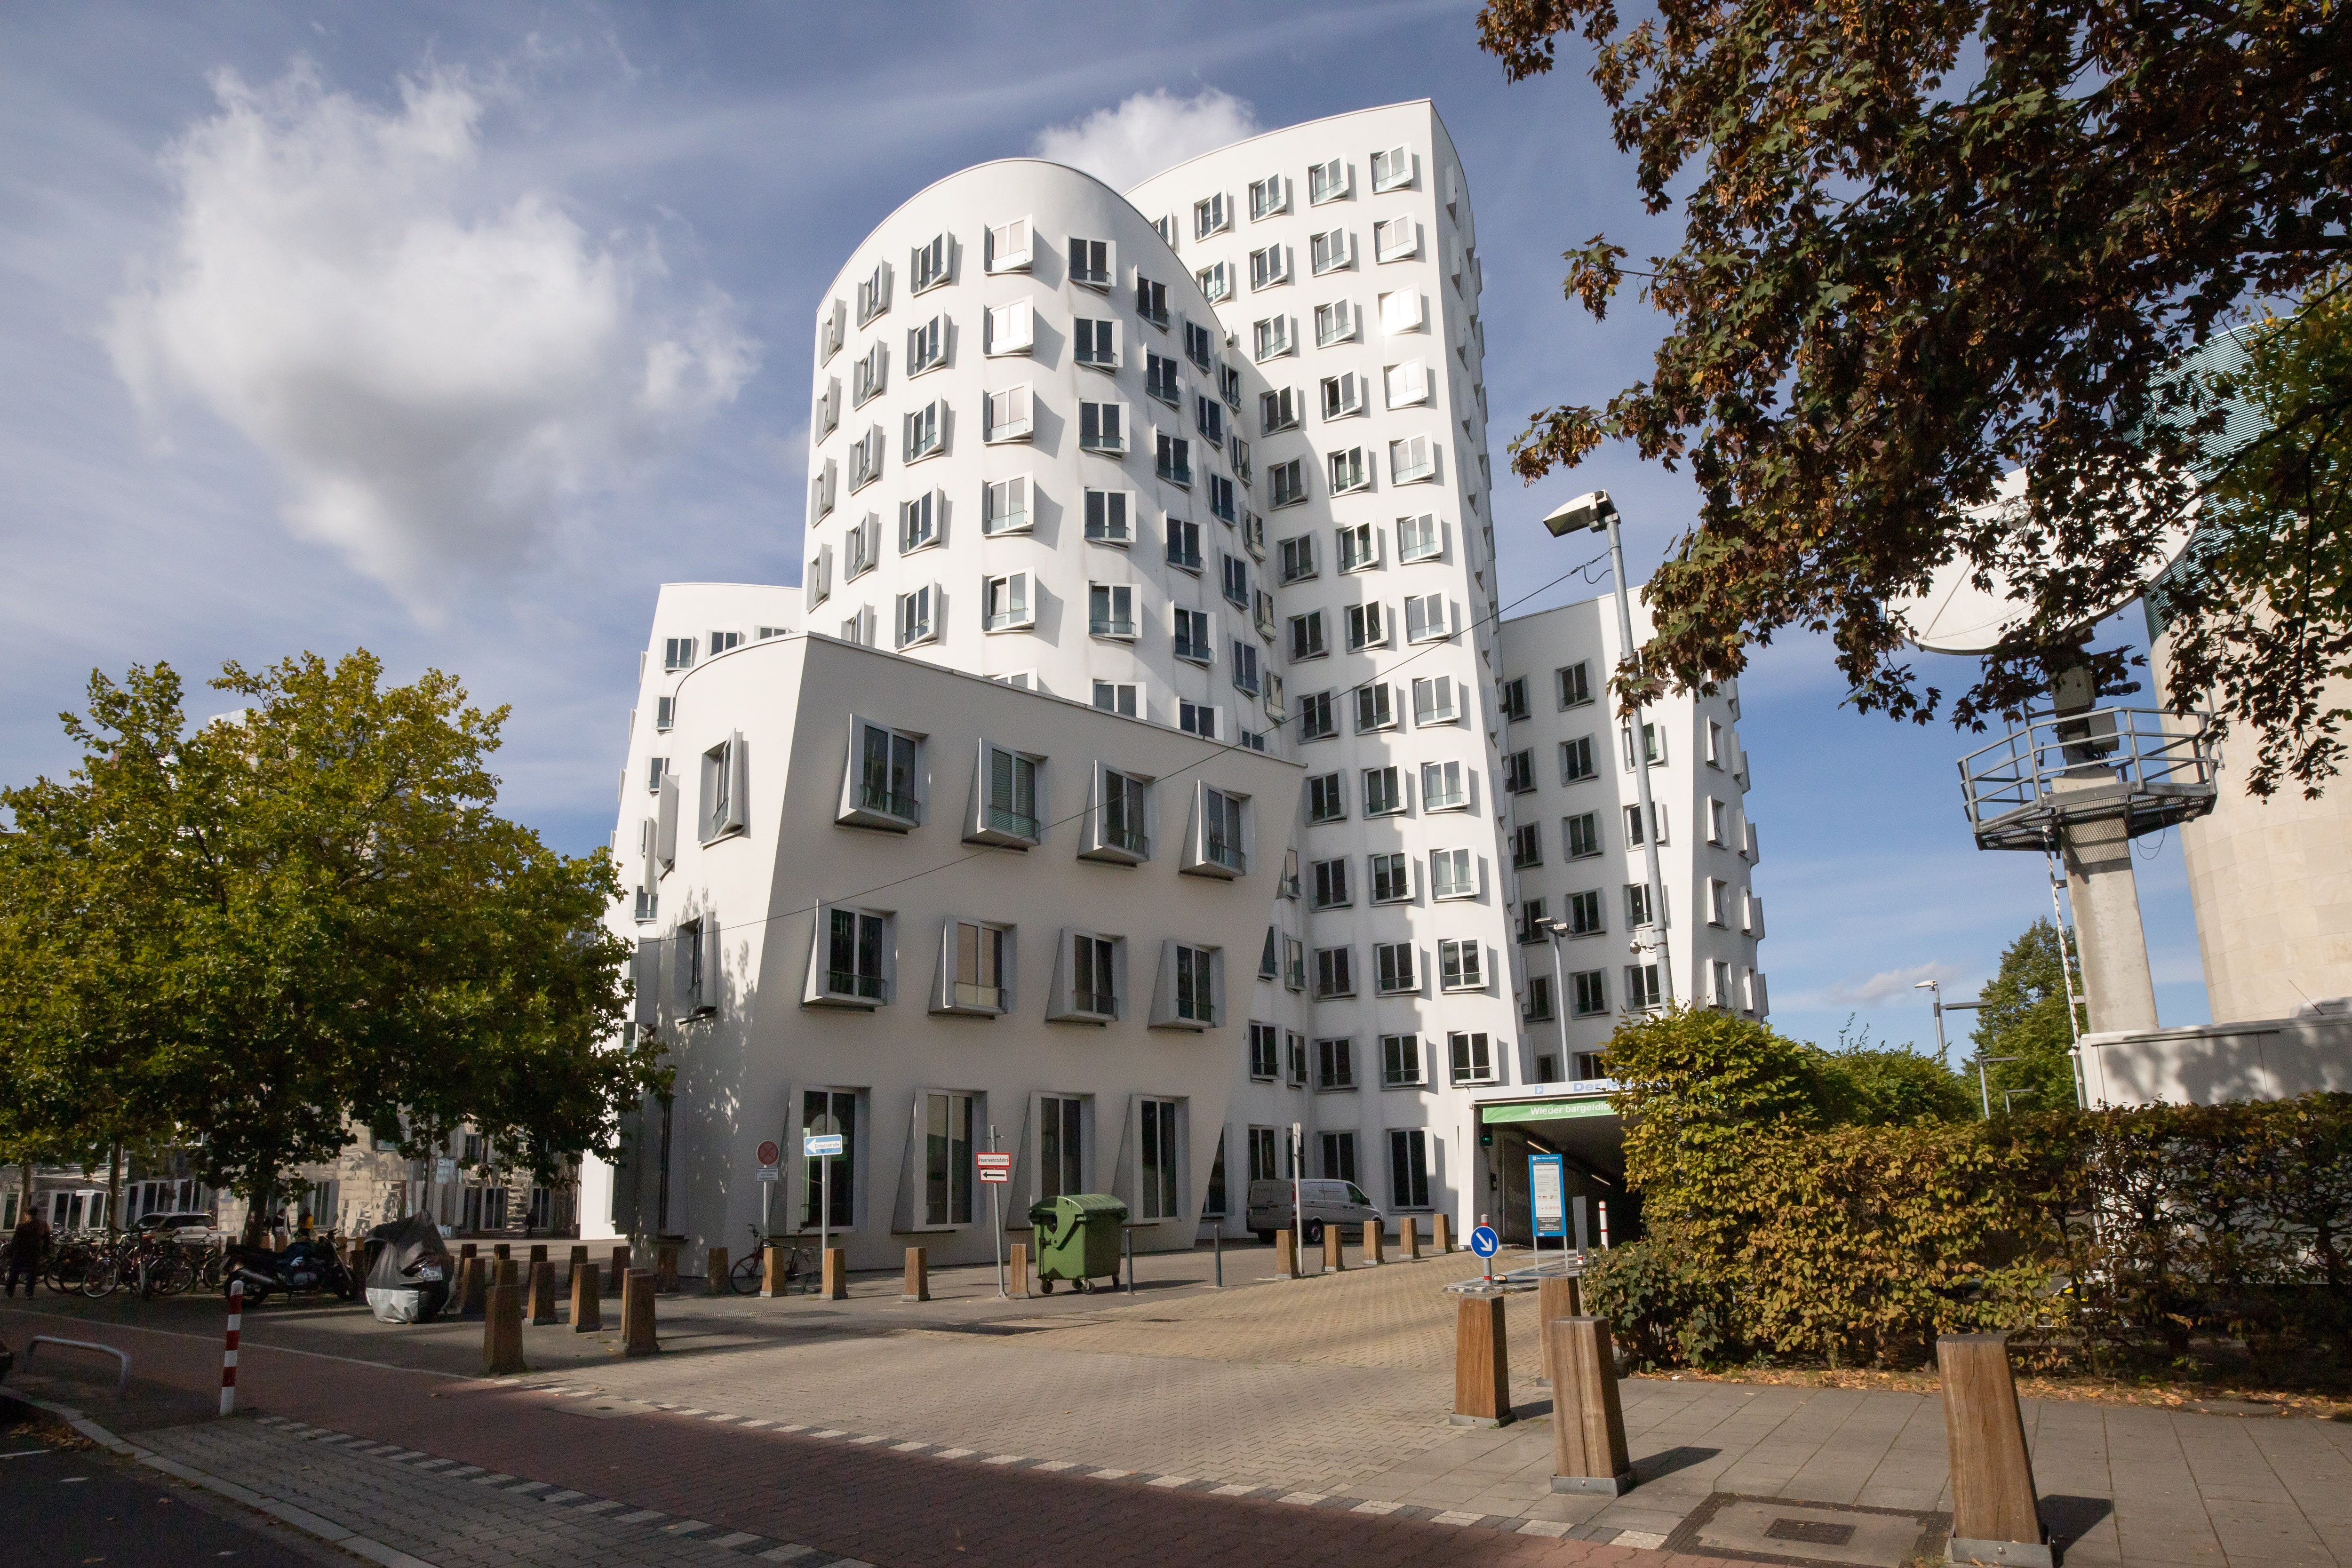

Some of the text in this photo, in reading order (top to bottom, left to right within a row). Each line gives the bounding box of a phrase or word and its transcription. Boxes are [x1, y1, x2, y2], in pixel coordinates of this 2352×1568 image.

[1573, 1082, 1601, 1091] Der
[1531, 1102, 1611, 1115] Wieder bargeldlo
